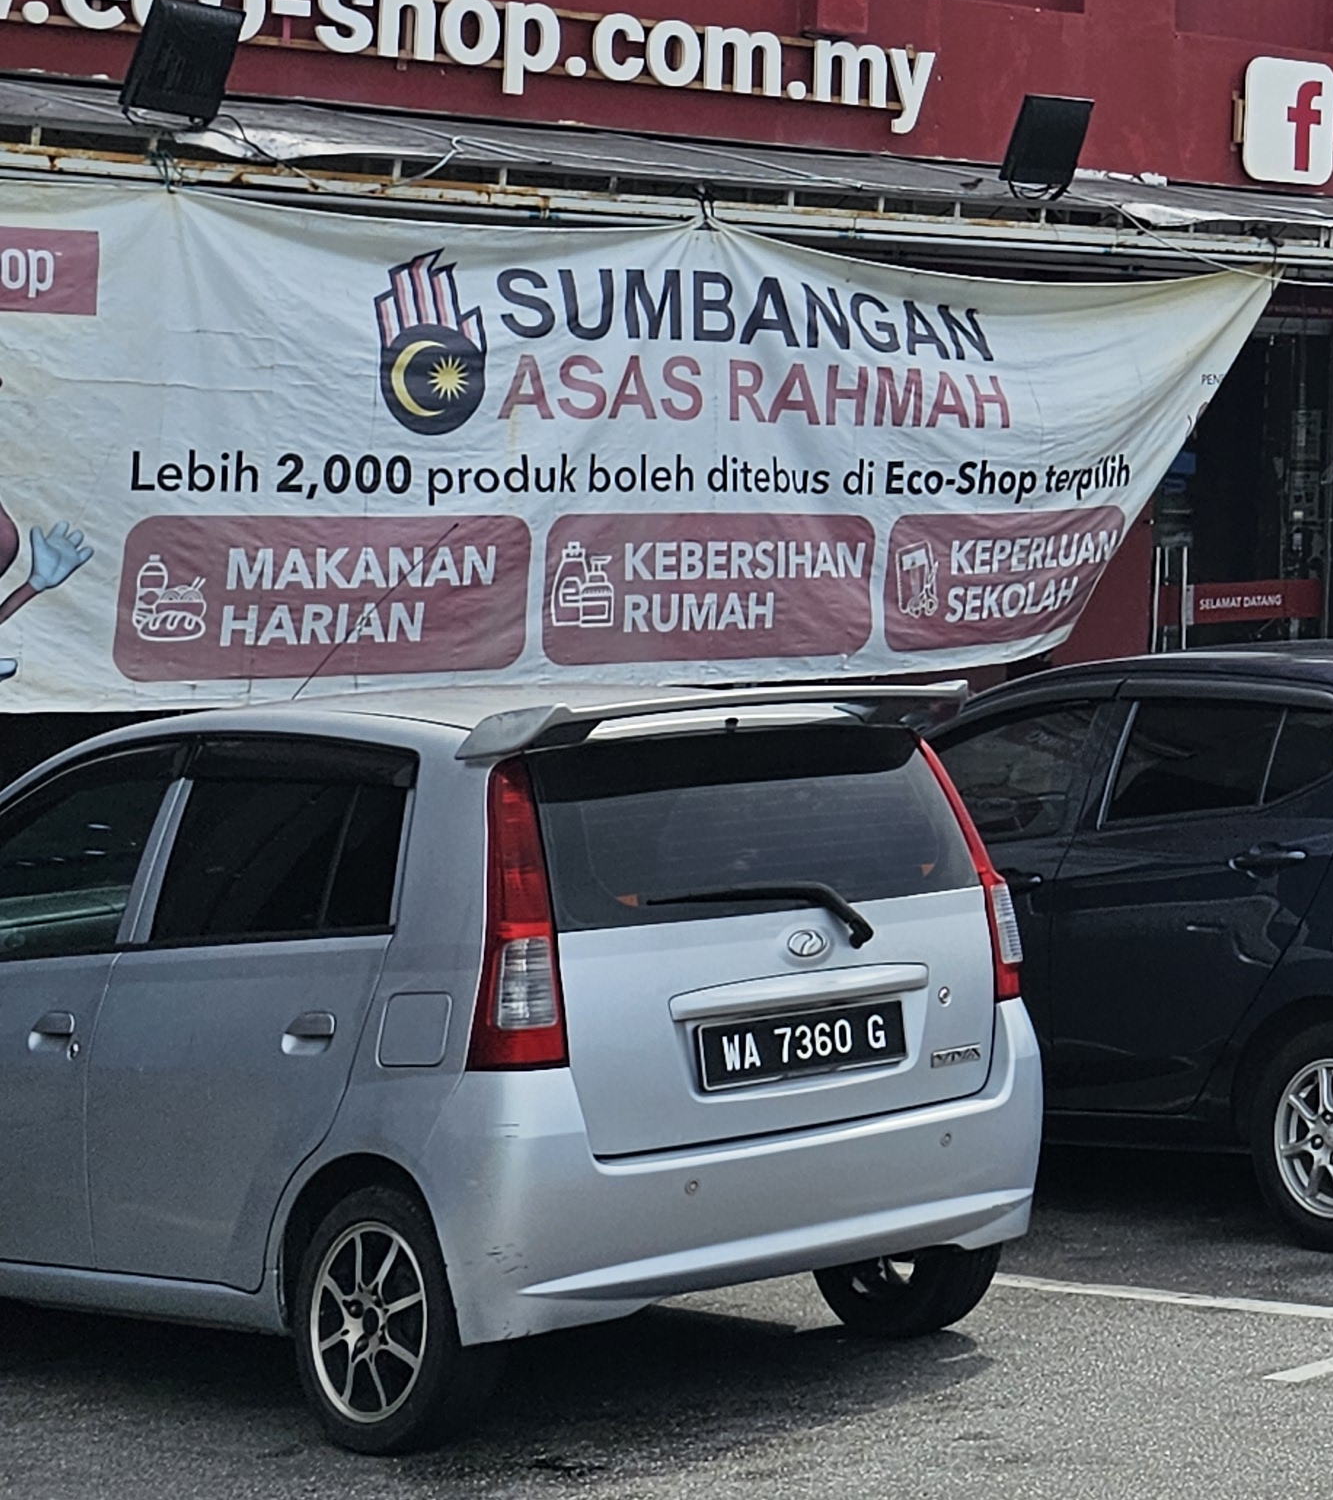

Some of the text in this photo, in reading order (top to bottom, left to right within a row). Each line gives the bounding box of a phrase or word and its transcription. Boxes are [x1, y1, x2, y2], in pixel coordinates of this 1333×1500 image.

[497, 268, 995, 362] SUMBANGAN
[498, 354, 1011, 430] ASAS RAHMAH
[130, 449, 260, 493] Lebih
[275, 453, 412, 500] 2,000
[427, 453, 576, 506] produk
[588, 453, 695, 493] boleh
[706, 455, 830, 495] ditebus
[841, 457, 875, 496] di
[885, 459, 1037, 505] Eco-Shop
[225, 545, 497, 591] MAKANAN
[623, 541, 867, 582] KEBERSIHAN
[949, 528, 1120, 577] KEPERLUAN
[623, 592, 775, 634] RUMAH
[943, 575, 1076, 624] SEKOLAH
[1199, 593, 1282, 611] SELAMAT DATANG
[219, 601, 426, 648] HARIAN
[721, 1014, 886, 1073] WA 7360 G
